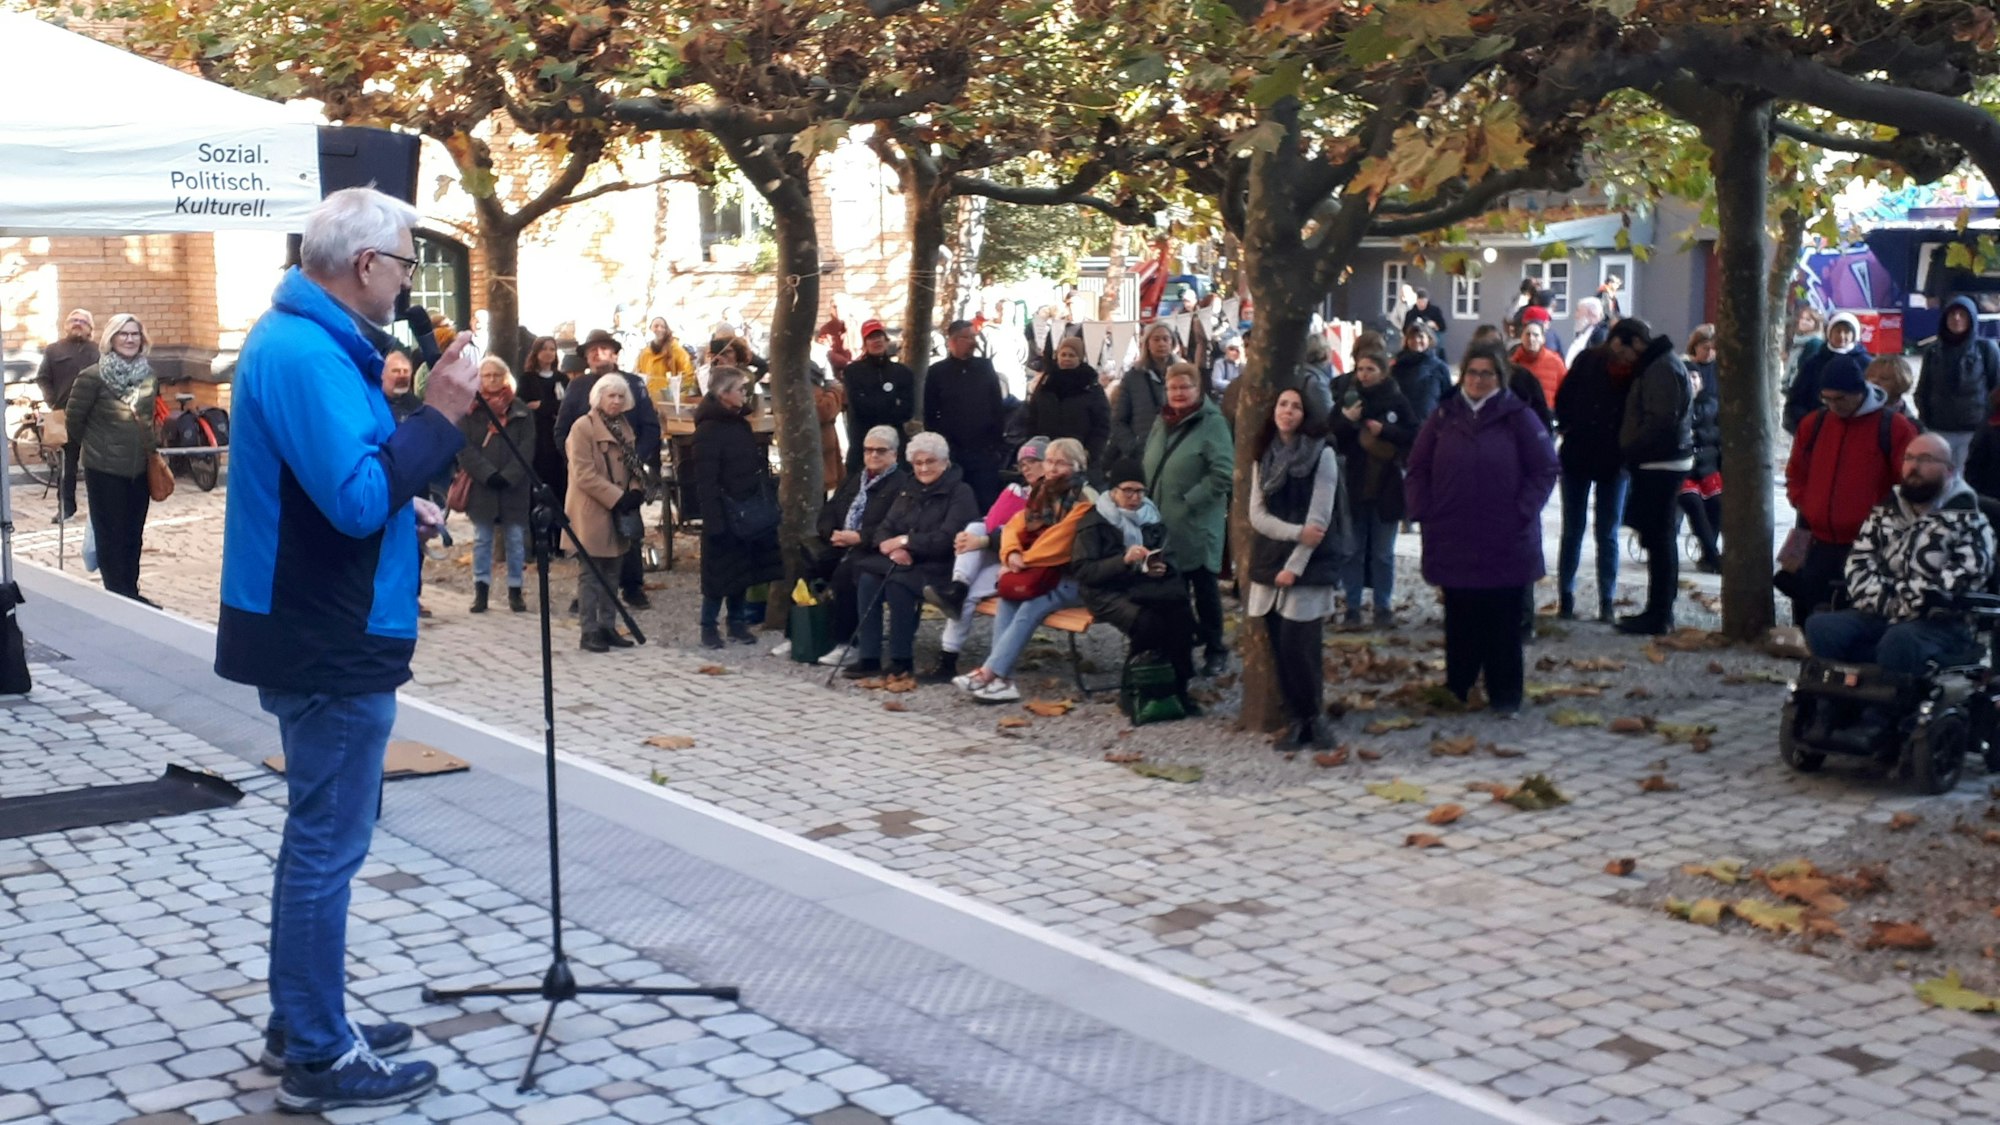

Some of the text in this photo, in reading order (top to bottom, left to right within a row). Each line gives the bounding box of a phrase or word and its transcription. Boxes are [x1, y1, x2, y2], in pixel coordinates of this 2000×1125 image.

[198, 142, 269, 164] Sozial.
[171, 170, 271, 191] Politisch.
[175, 196, 271, 218] Kulturell.
